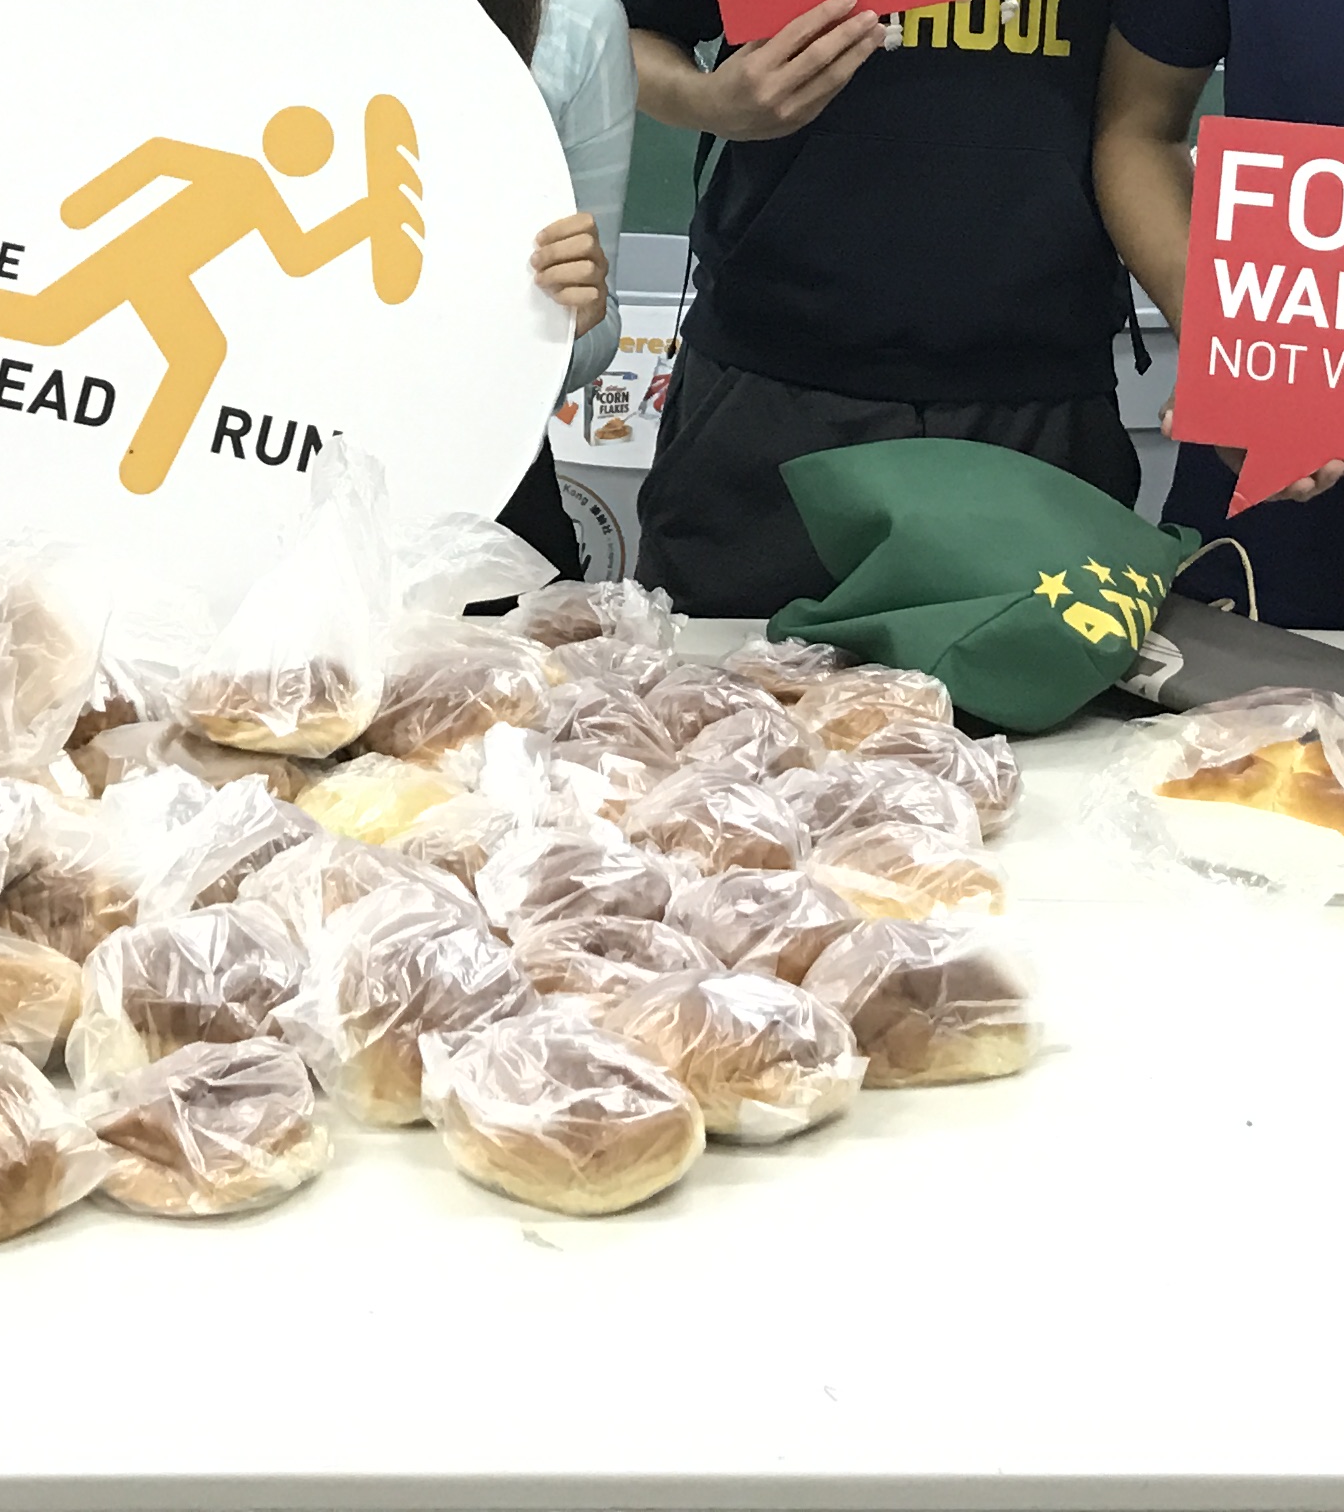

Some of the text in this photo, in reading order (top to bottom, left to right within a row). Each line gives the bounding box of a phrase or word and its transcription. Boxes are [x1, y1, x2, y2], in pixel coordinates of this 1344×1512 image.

[1208, 336, 1307, 385] NOT
[599, 390, 630, 405] CORN
[599, 403, 630, 415] FLAKES
[562, 482, 589, 507] Kong
